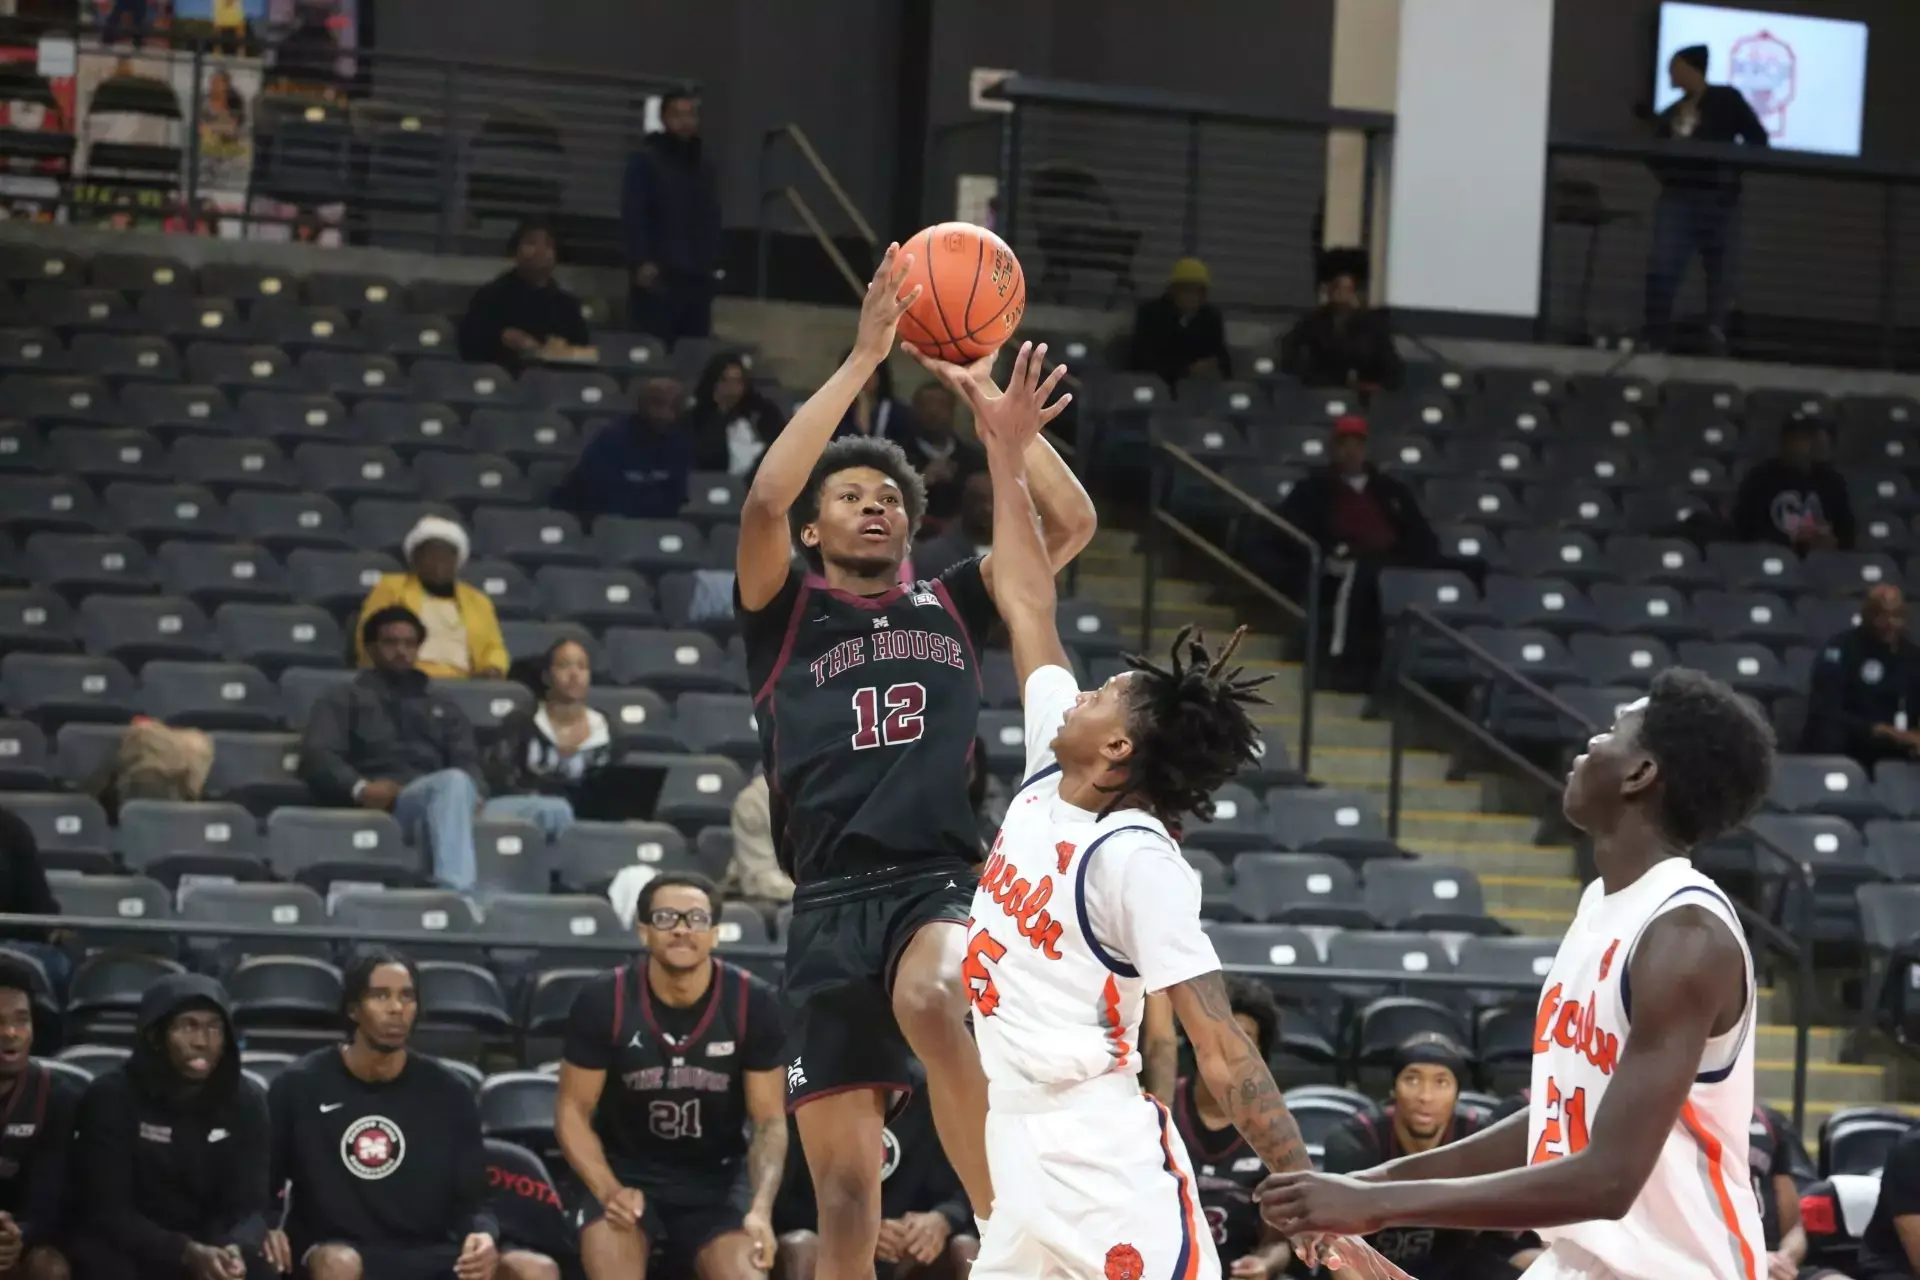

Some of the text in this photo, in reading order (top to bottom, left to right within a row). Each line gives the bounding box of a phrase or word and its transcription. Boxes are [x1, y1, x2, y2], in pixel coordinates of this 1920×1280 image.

[810, 630, 964, 687] THE HOUSE
[851, 681, 926, 751] 12
[961, 916, 1008, 1017] 5
[648, 1098, 702, 1139] 21
